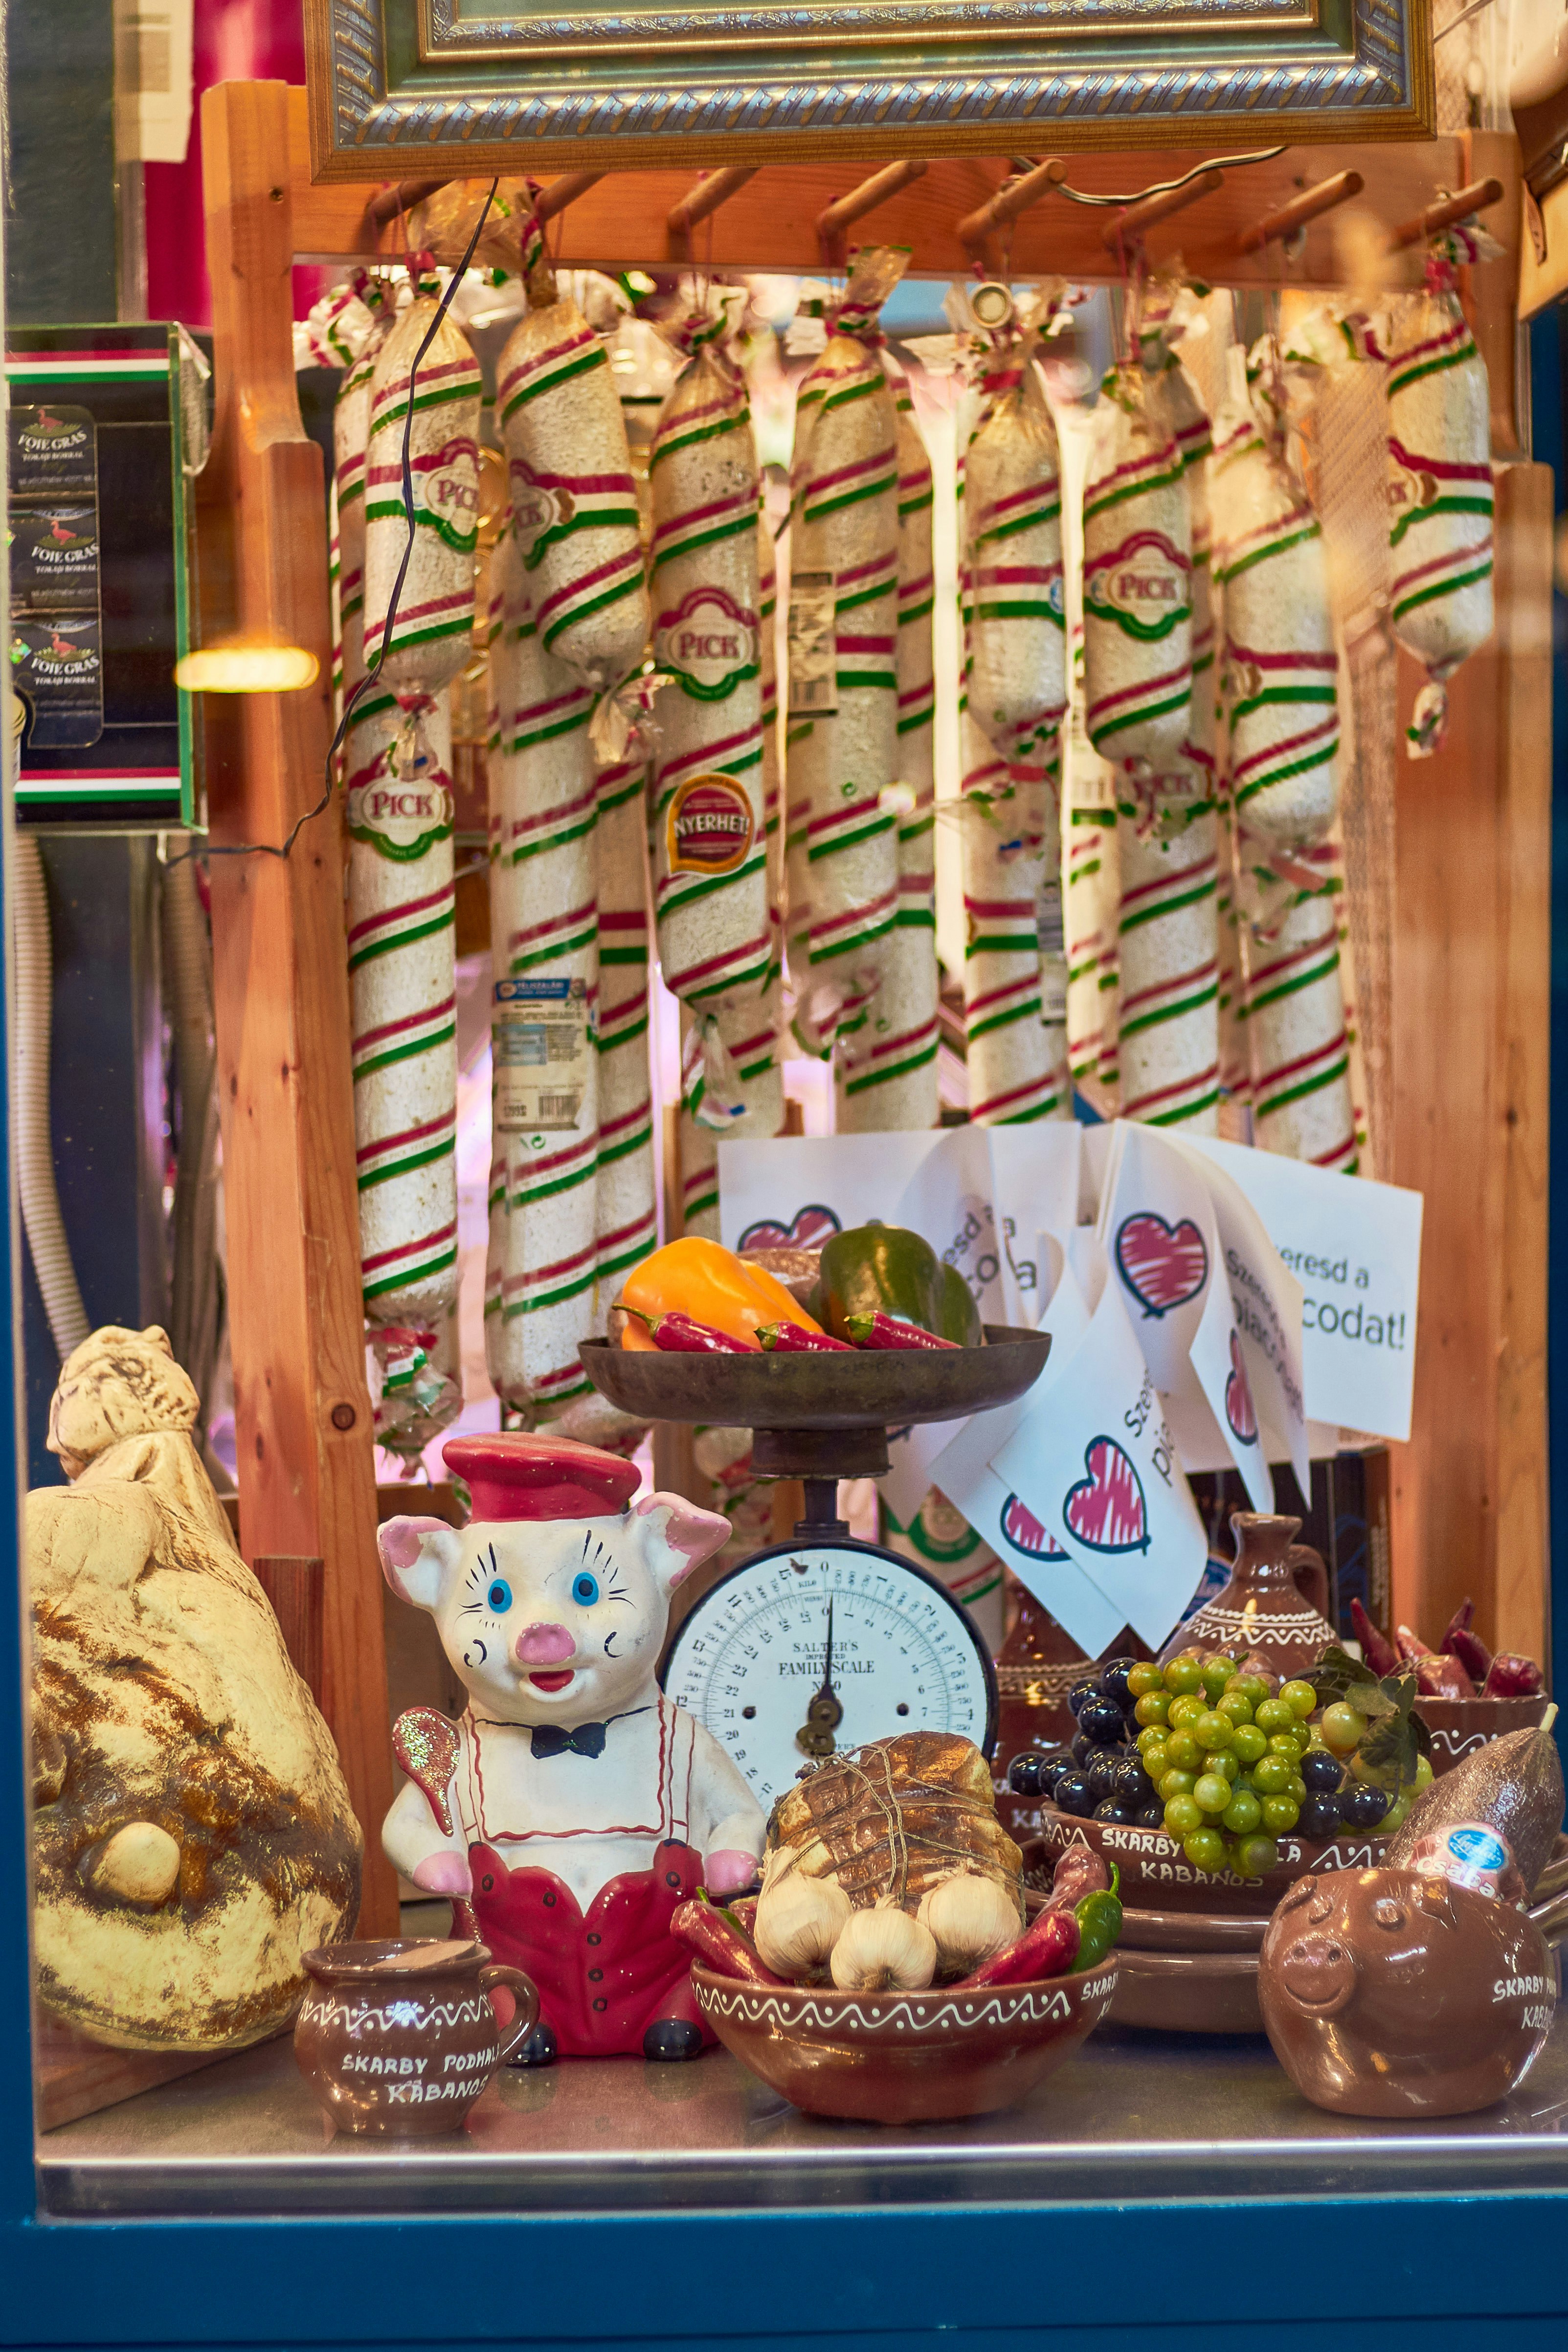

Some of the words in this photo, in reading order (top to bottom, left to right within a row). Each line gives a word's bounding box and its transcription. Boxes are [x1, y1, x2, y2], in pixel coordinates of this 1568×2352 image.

[1120, 573, 1177, 598] PICK
[680, 632, 739, 658] PICK
[373, 791, 432, 818] PICK
[673, 814, 750, 838] NYERHET!
[1354, 1267, 1369, 1289] a
[1302, 1297, 1405, 1351] codat!
[821, 1561, 829, 1573] 0
[798, 1580, 817, 1588] KILO
[924, 1604, 937, 1616] 2
[692, 1639, 706, 1653] 13
[732, 1663, 748, 1678] 23
[779, 1662, 827, 1676] FAMILY
[832, 1660, 874, 1674] SCALE
[725, 1684, 739, 1697] 22
[918, 1684, 925, 1695] 6
[676, 1695, 688, 1708] 12
[723, 1708, 735, 1718] 21
[921, 1706, 928, 1717] 7
[726, 1729, 739, 1741] 20
[734, 1749, 746, 1761] 19
[745, 1767, 759, 1779] 18
[761, 1782, 773, 1794] 17
[1101, 1828, 1181, 1858] SKARBY
[1492, 1975, 1544, 2003] SKARBY
[341, 2053, 428, 2075] SKARBY
[388, 2074, 489, 2104] KABANOS
